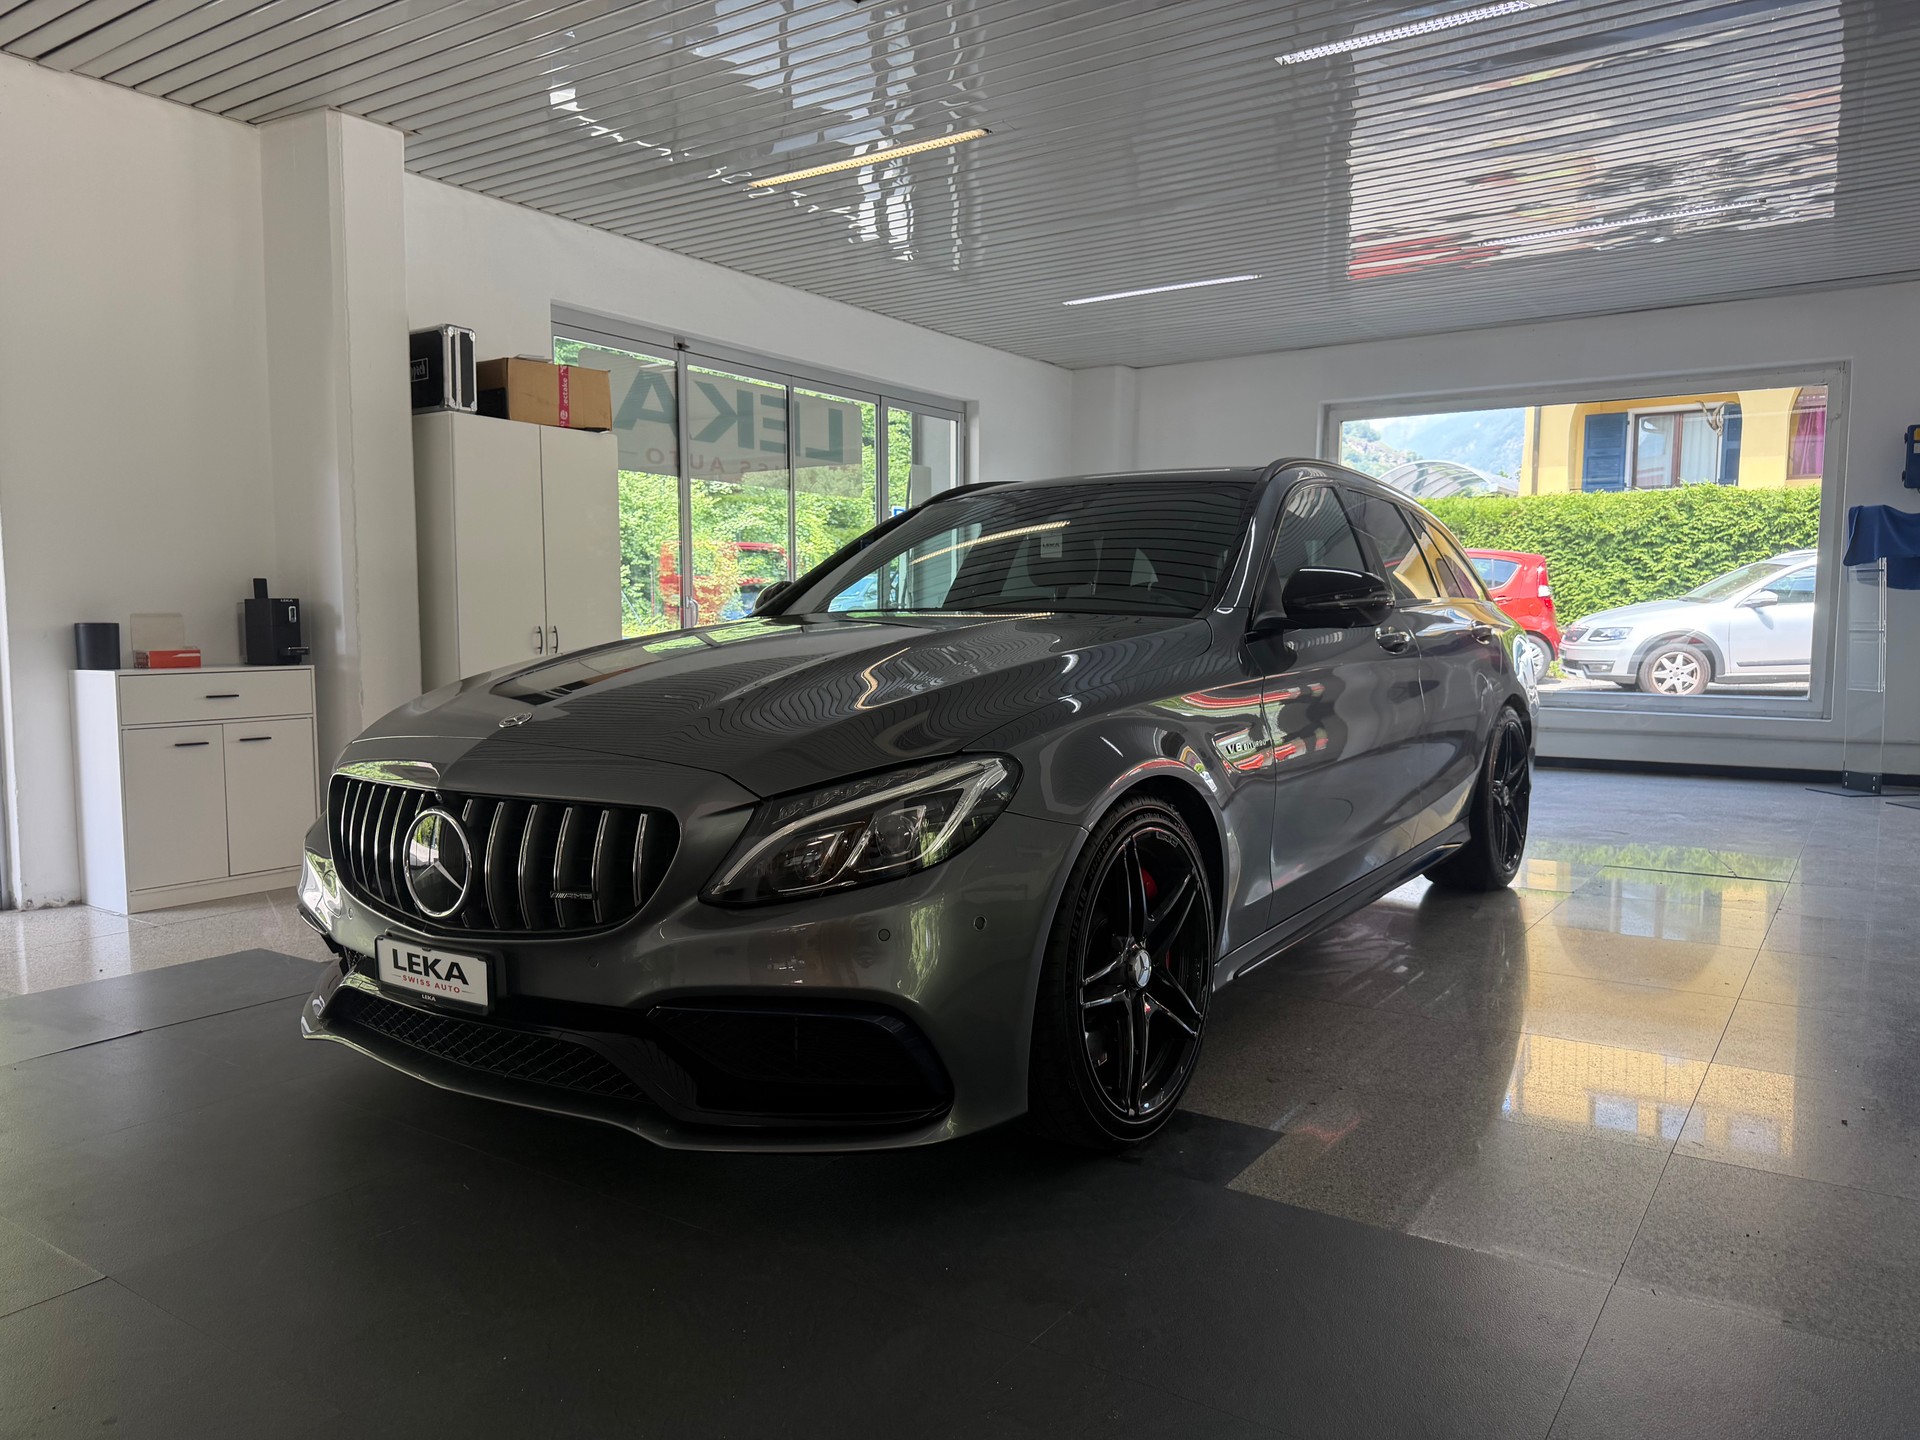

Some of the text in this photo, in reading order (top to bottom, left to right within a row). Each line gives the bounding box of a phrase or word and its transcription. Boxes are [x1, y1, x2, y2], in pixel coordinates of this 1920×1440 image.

[392, 948, 469, 986] LEKA
[402, 974, 461, 994] SWISS AUTO
[421, 993, 437, 1002] LEKA
